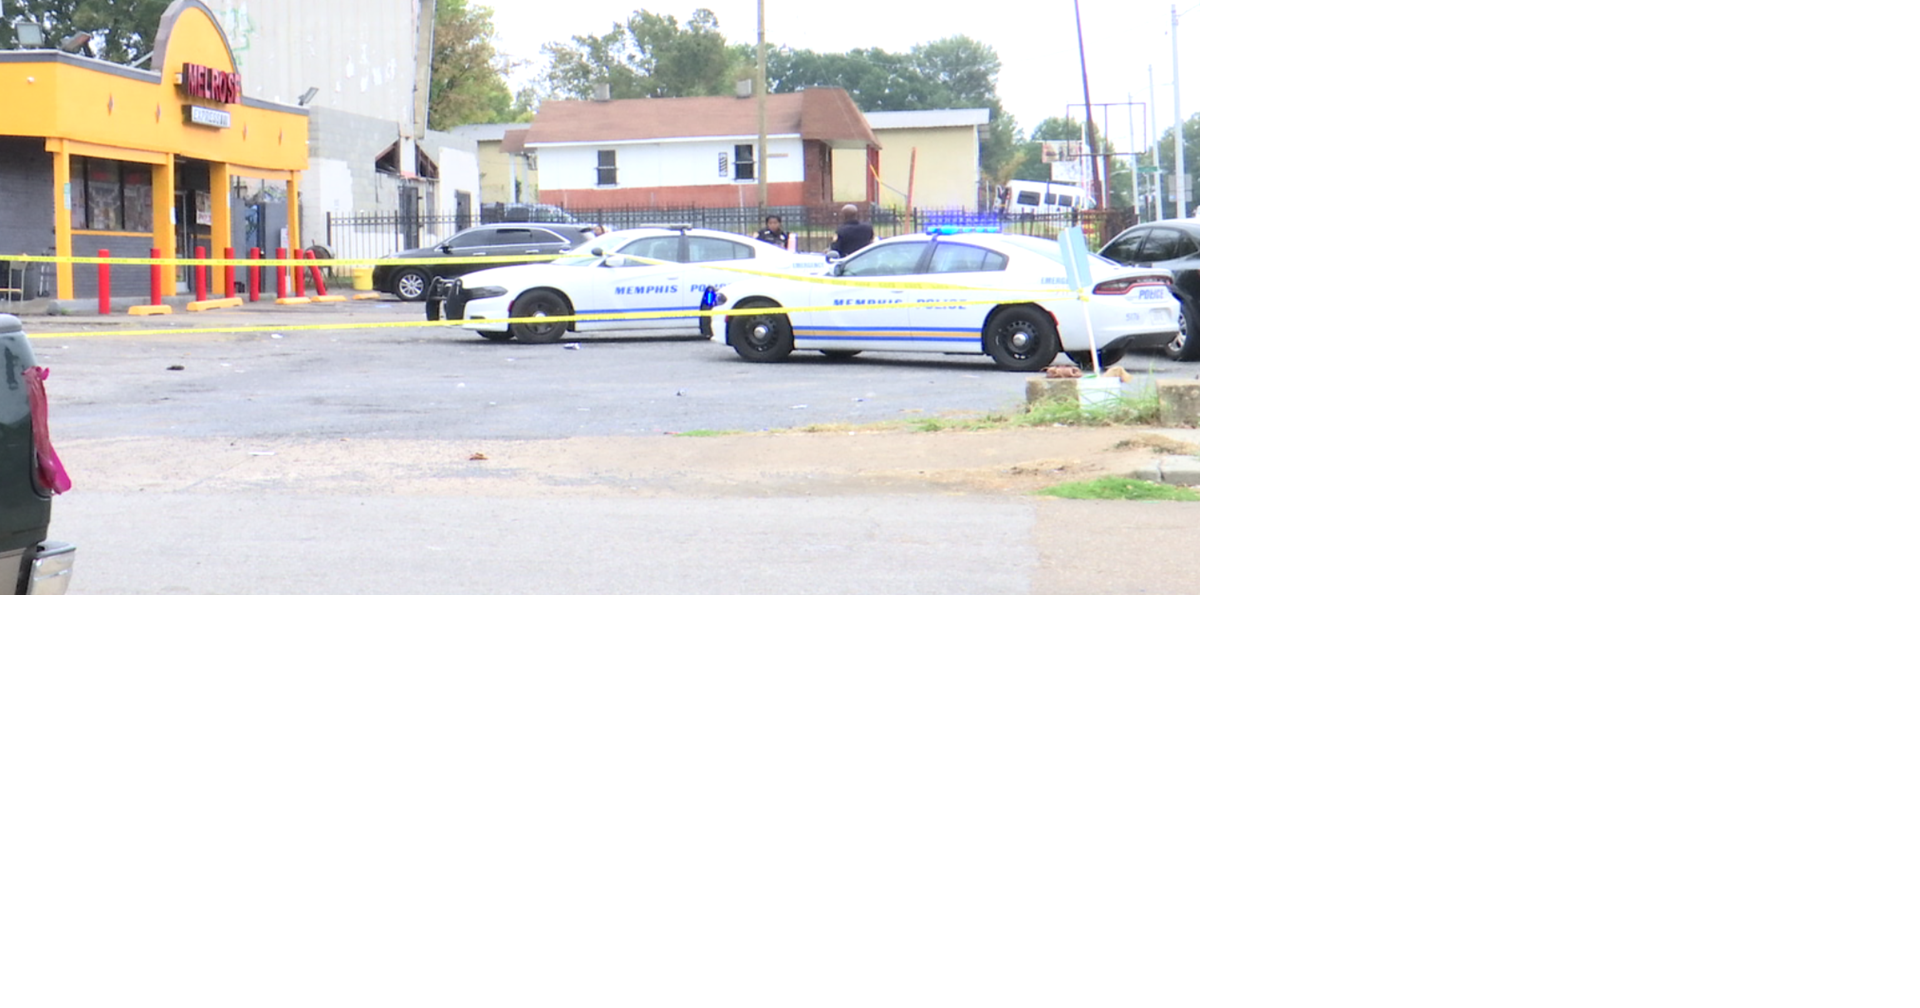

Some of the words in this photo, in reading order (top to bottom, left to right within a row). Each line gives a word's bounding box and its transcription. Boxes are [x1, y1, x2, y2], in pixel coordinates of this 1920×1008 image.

[187, 63, 241, 104] MELROSE
[614, 285, 679, 295] MEMPHIS
[690, 283, 731, 293] POIC
[1138, 288, 1164, 300] POLICE
